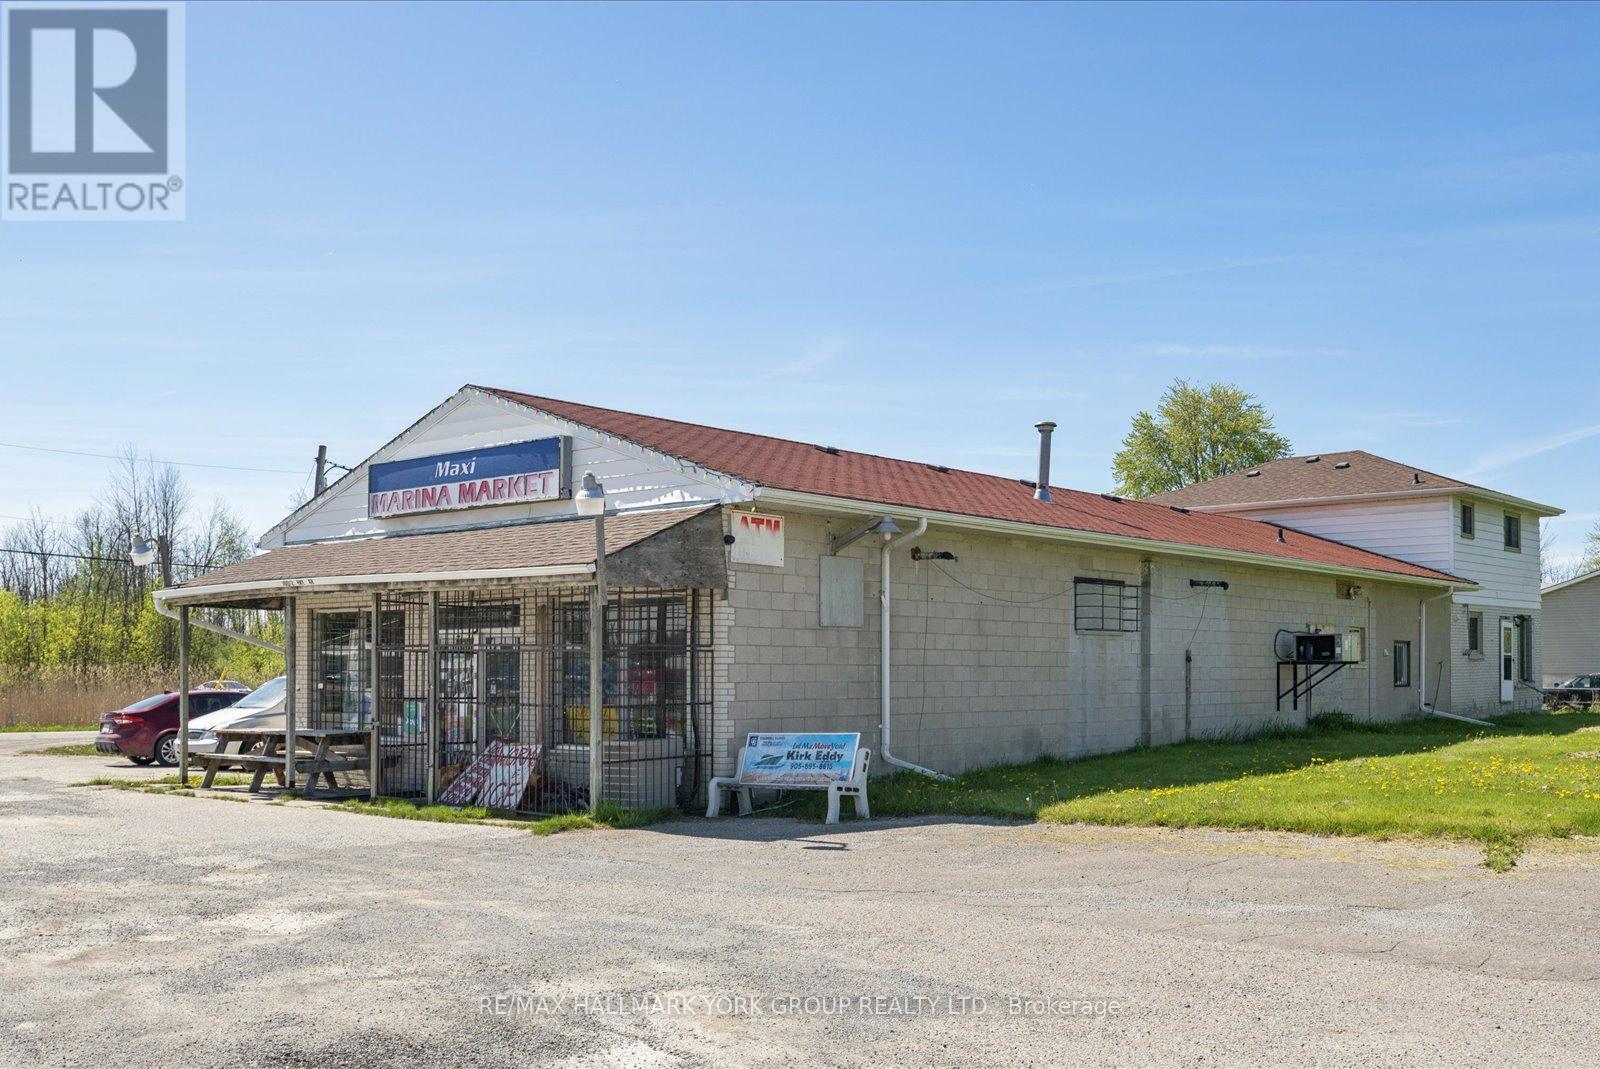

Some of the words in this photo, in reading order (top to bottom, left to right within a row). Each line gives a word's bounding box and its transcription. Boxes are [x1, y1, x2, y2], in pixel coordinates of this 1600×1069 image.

[434, 457, 476, 478] Maxi
[371, 485, 451, 514] MARINA
[458, 471, 553, 504] MARKET
[786, 750, 812, 761] Kirk
[815, 750, 844, 763] Eddy
